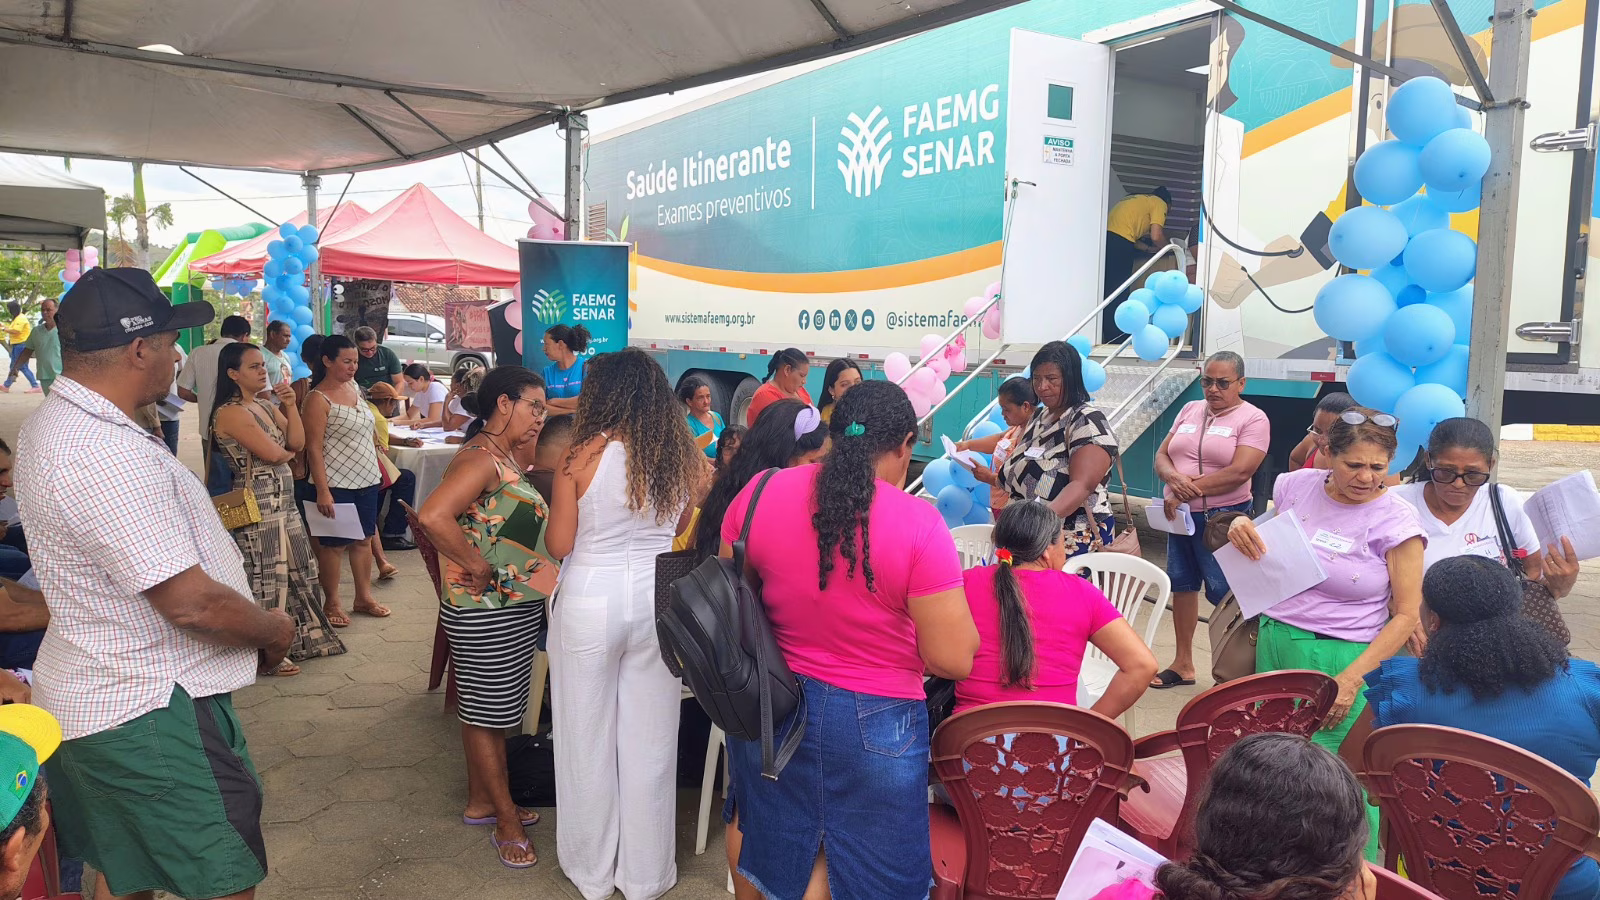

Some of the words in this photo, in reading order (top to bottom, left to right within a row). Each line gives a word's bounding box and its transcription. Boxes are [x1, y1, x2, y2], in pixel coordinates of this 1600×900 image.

[903, 83, 999, 138] FAEMG
[1048, 138, 1070, 146] AVISO
[901, 130, 995, 178] SENAR
[626, 159, 678, 200] Saúde
[683, 136, 792, 188] Itinerante
[657, 202, 702, 226] Exames
[706, 185, 791, 224] preventivos
[572, 293, 616, 307] FAEMG
[572, 308, 616, 320] SENAR
[664, 311, 756, 327] www.sistemafaemg.org.br
[886, 309, 981, 330] @sistemafae
